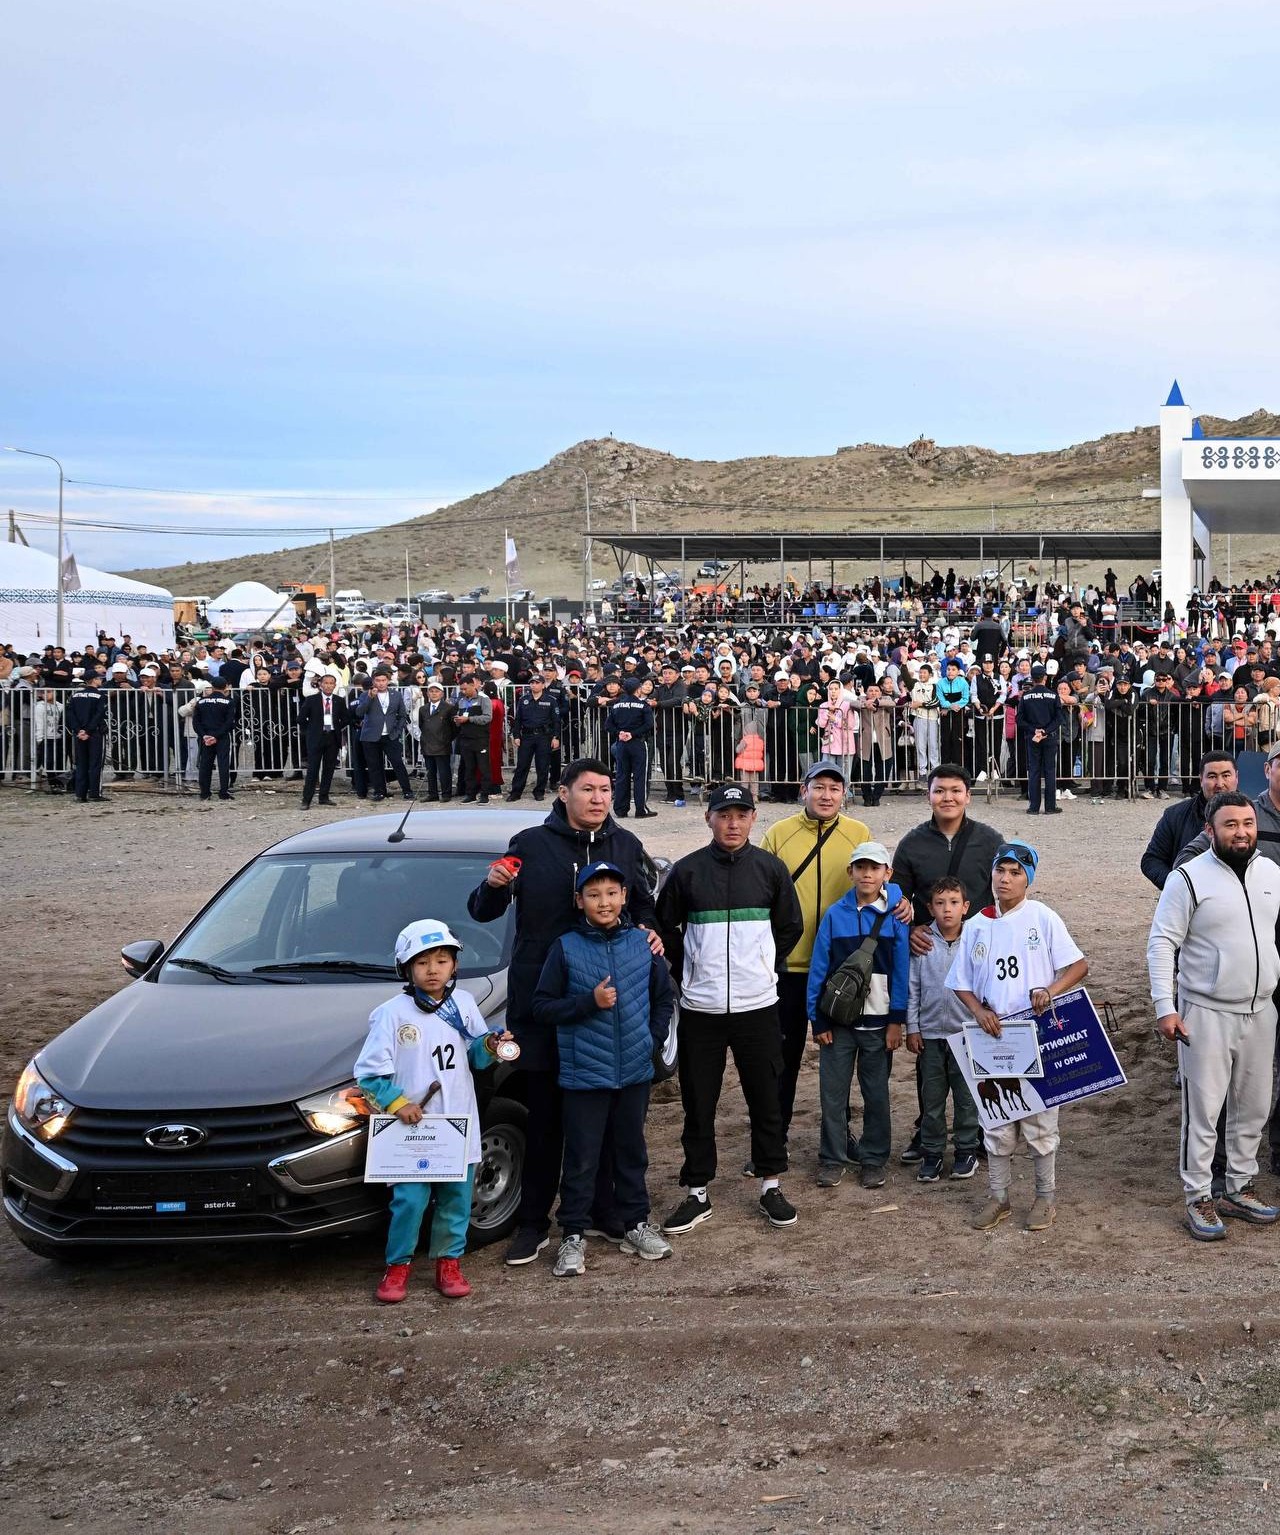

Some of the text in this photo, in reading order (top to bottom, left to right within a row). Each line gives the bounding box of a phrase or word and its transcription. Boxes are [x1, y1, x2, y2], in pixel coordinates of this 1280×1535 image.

[996, 955, 1019, 981] 38
[1040, 1029, 1088, 1054] РТИФИКАТ
[431, 1043, 456, 1072] 12
[1054, 1060, 1063, 1070] IV
[1063, 1052, 1088, 1066] ОРЫН
[404, 1134, 436, 1142] ДИПЛОМ
[204, 1201, 236, 1209] aster.kz
